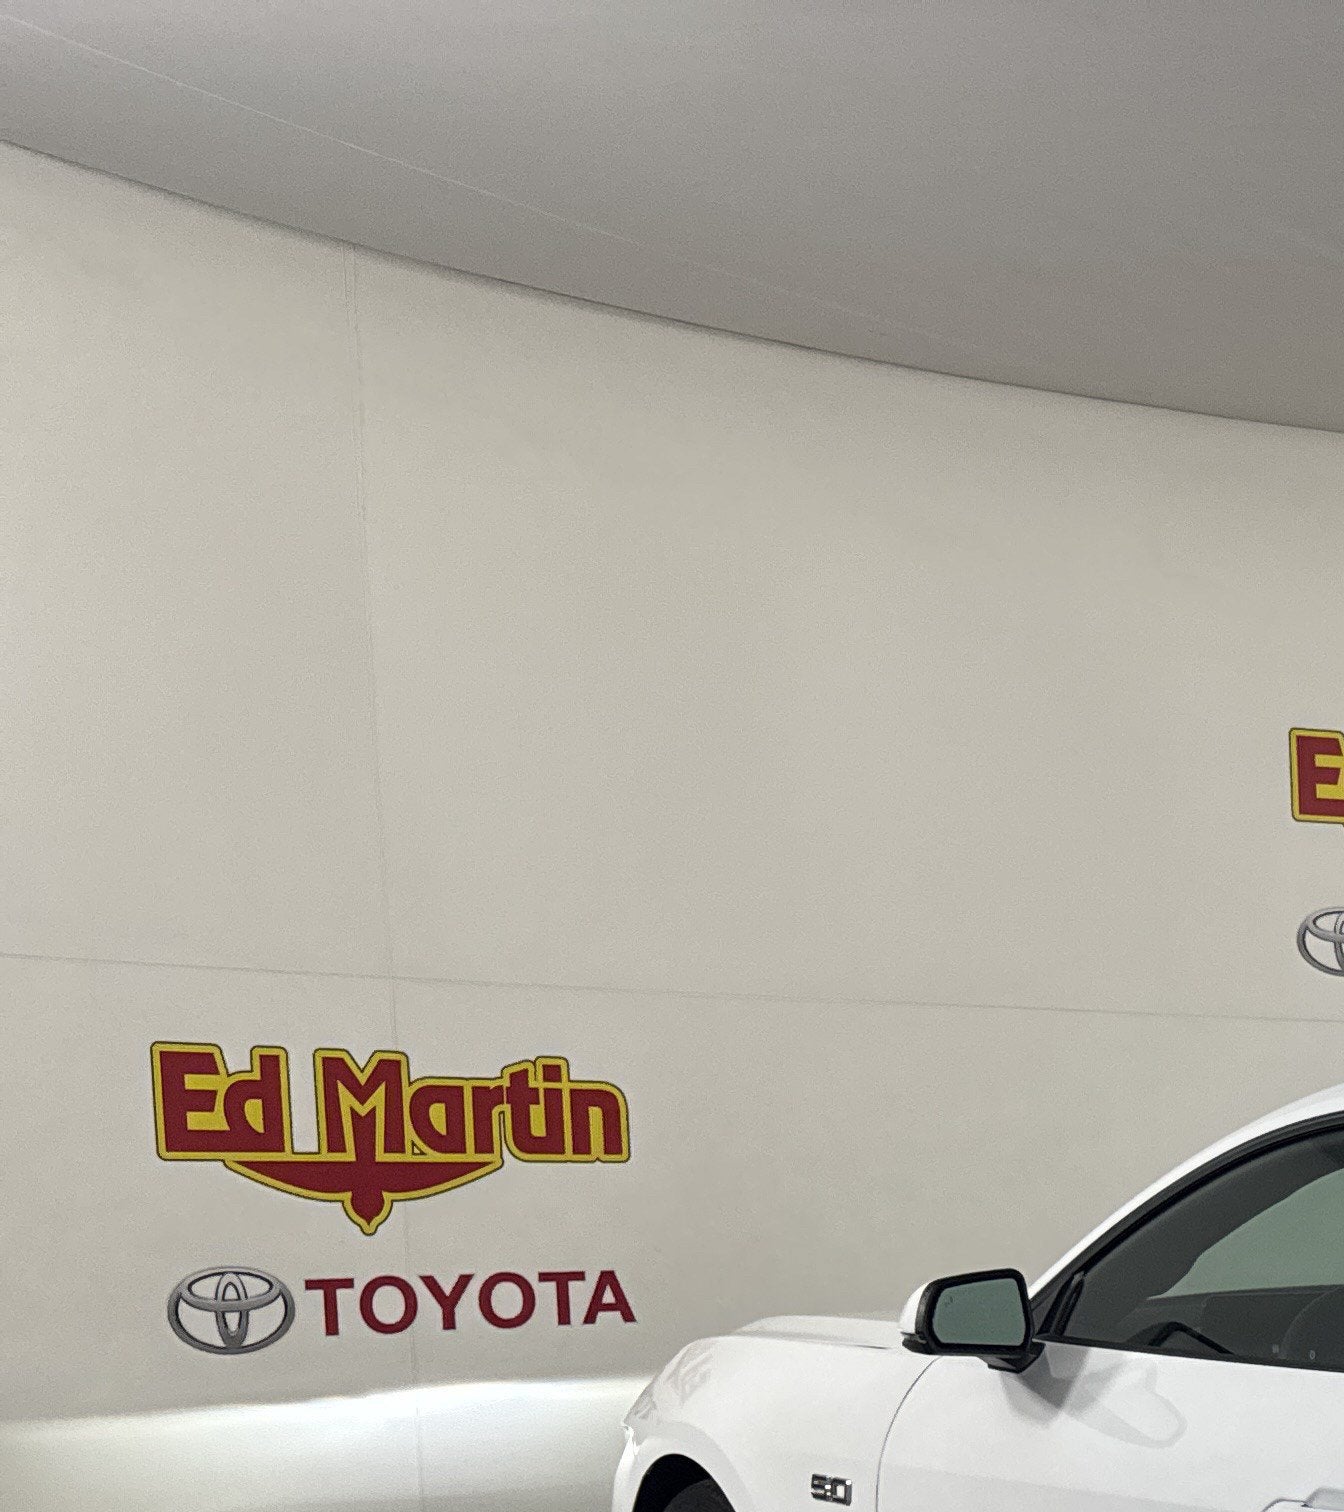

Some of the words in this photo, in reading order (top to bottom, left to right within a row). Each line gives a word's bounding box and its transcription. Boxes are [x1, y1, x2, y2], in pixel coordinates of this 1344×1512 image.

[150, 1041, 292, 1161] Ed
[313, 1049, 631, 1163] Martin
[305, 1270, 637, 1336] TOYOTA
